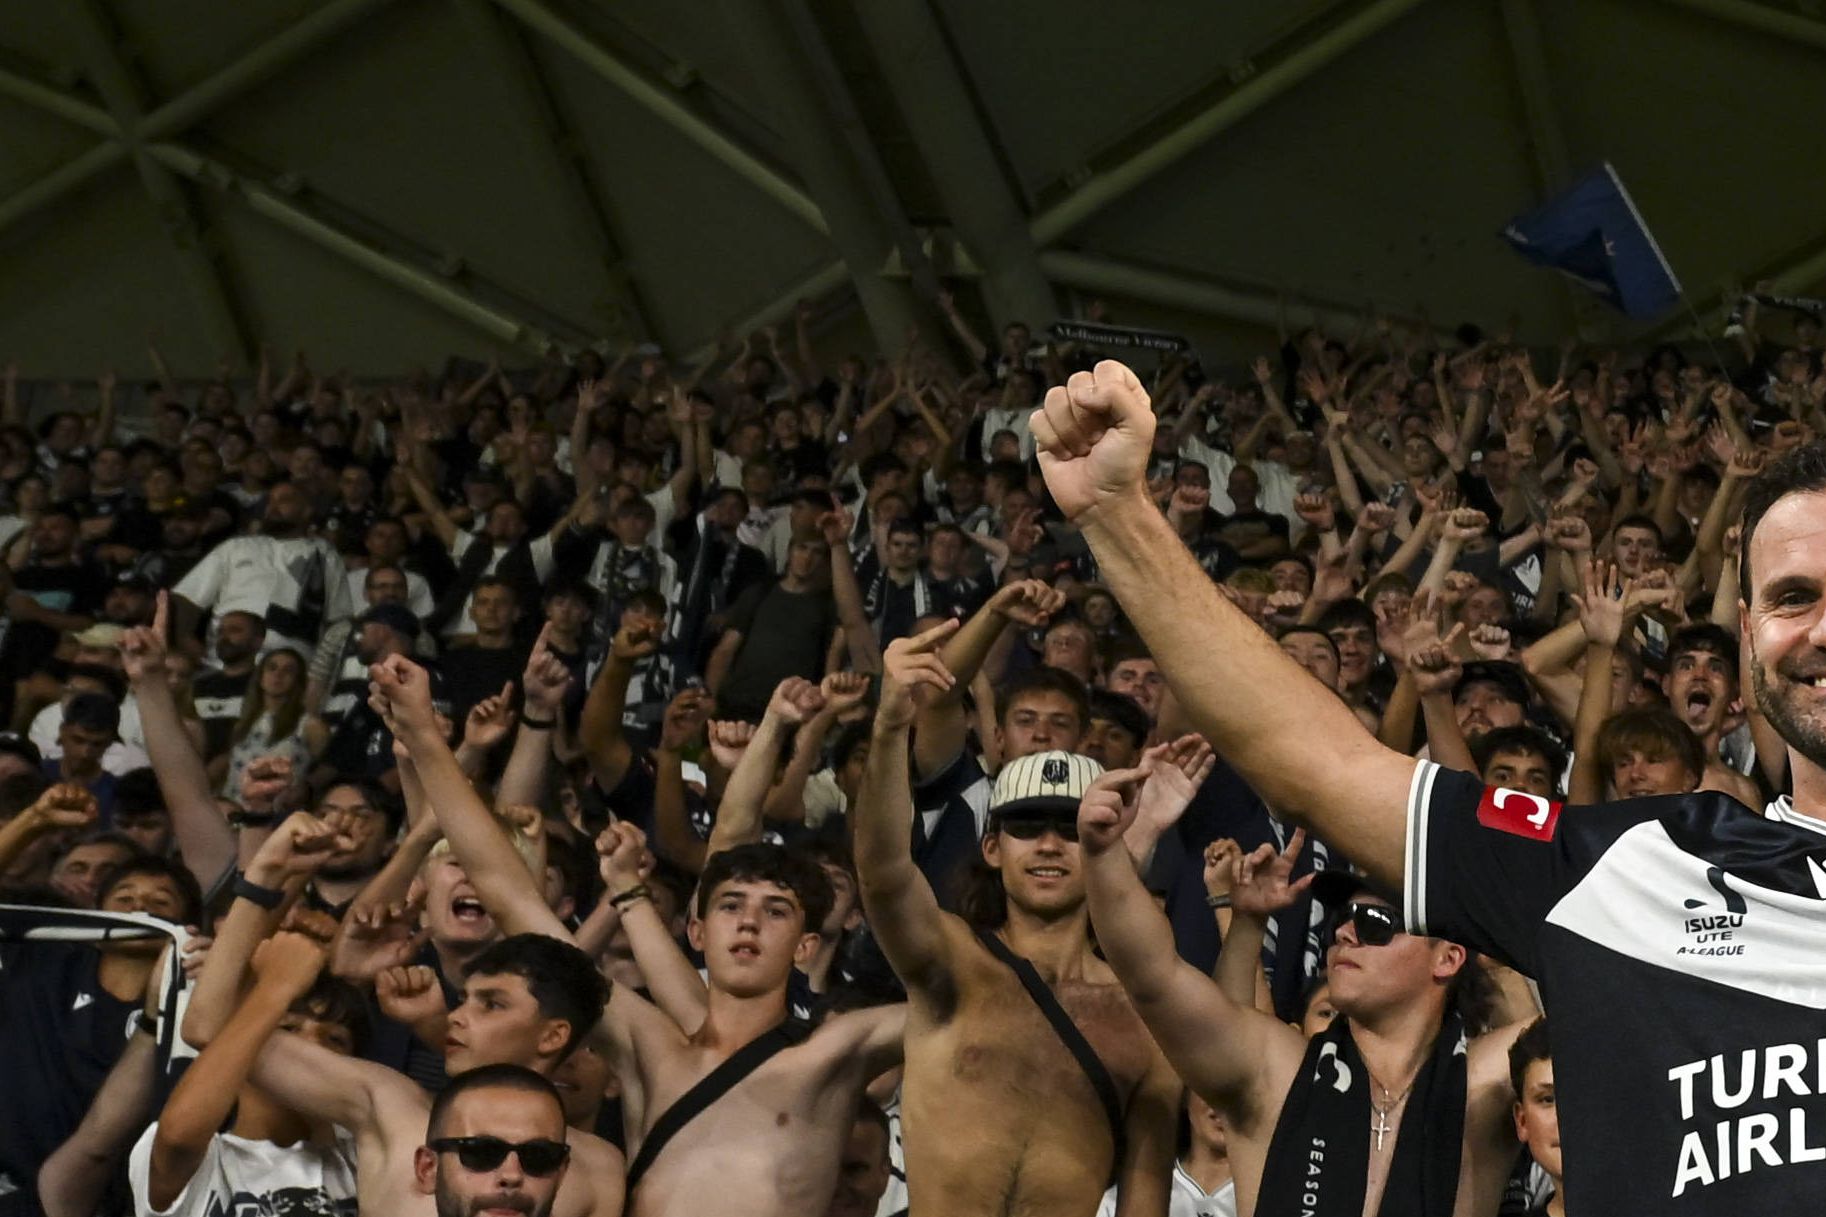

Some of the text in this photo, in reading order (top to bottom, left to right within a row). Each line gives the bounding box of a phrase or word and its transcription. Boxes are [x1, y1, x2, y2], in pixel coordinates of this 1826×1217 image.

[1684, 914, 1744, 934] ISUZU
[1696, 931, 1733, 944] UTE
[1676, 944, 1746, 957] A-LEAGUE
